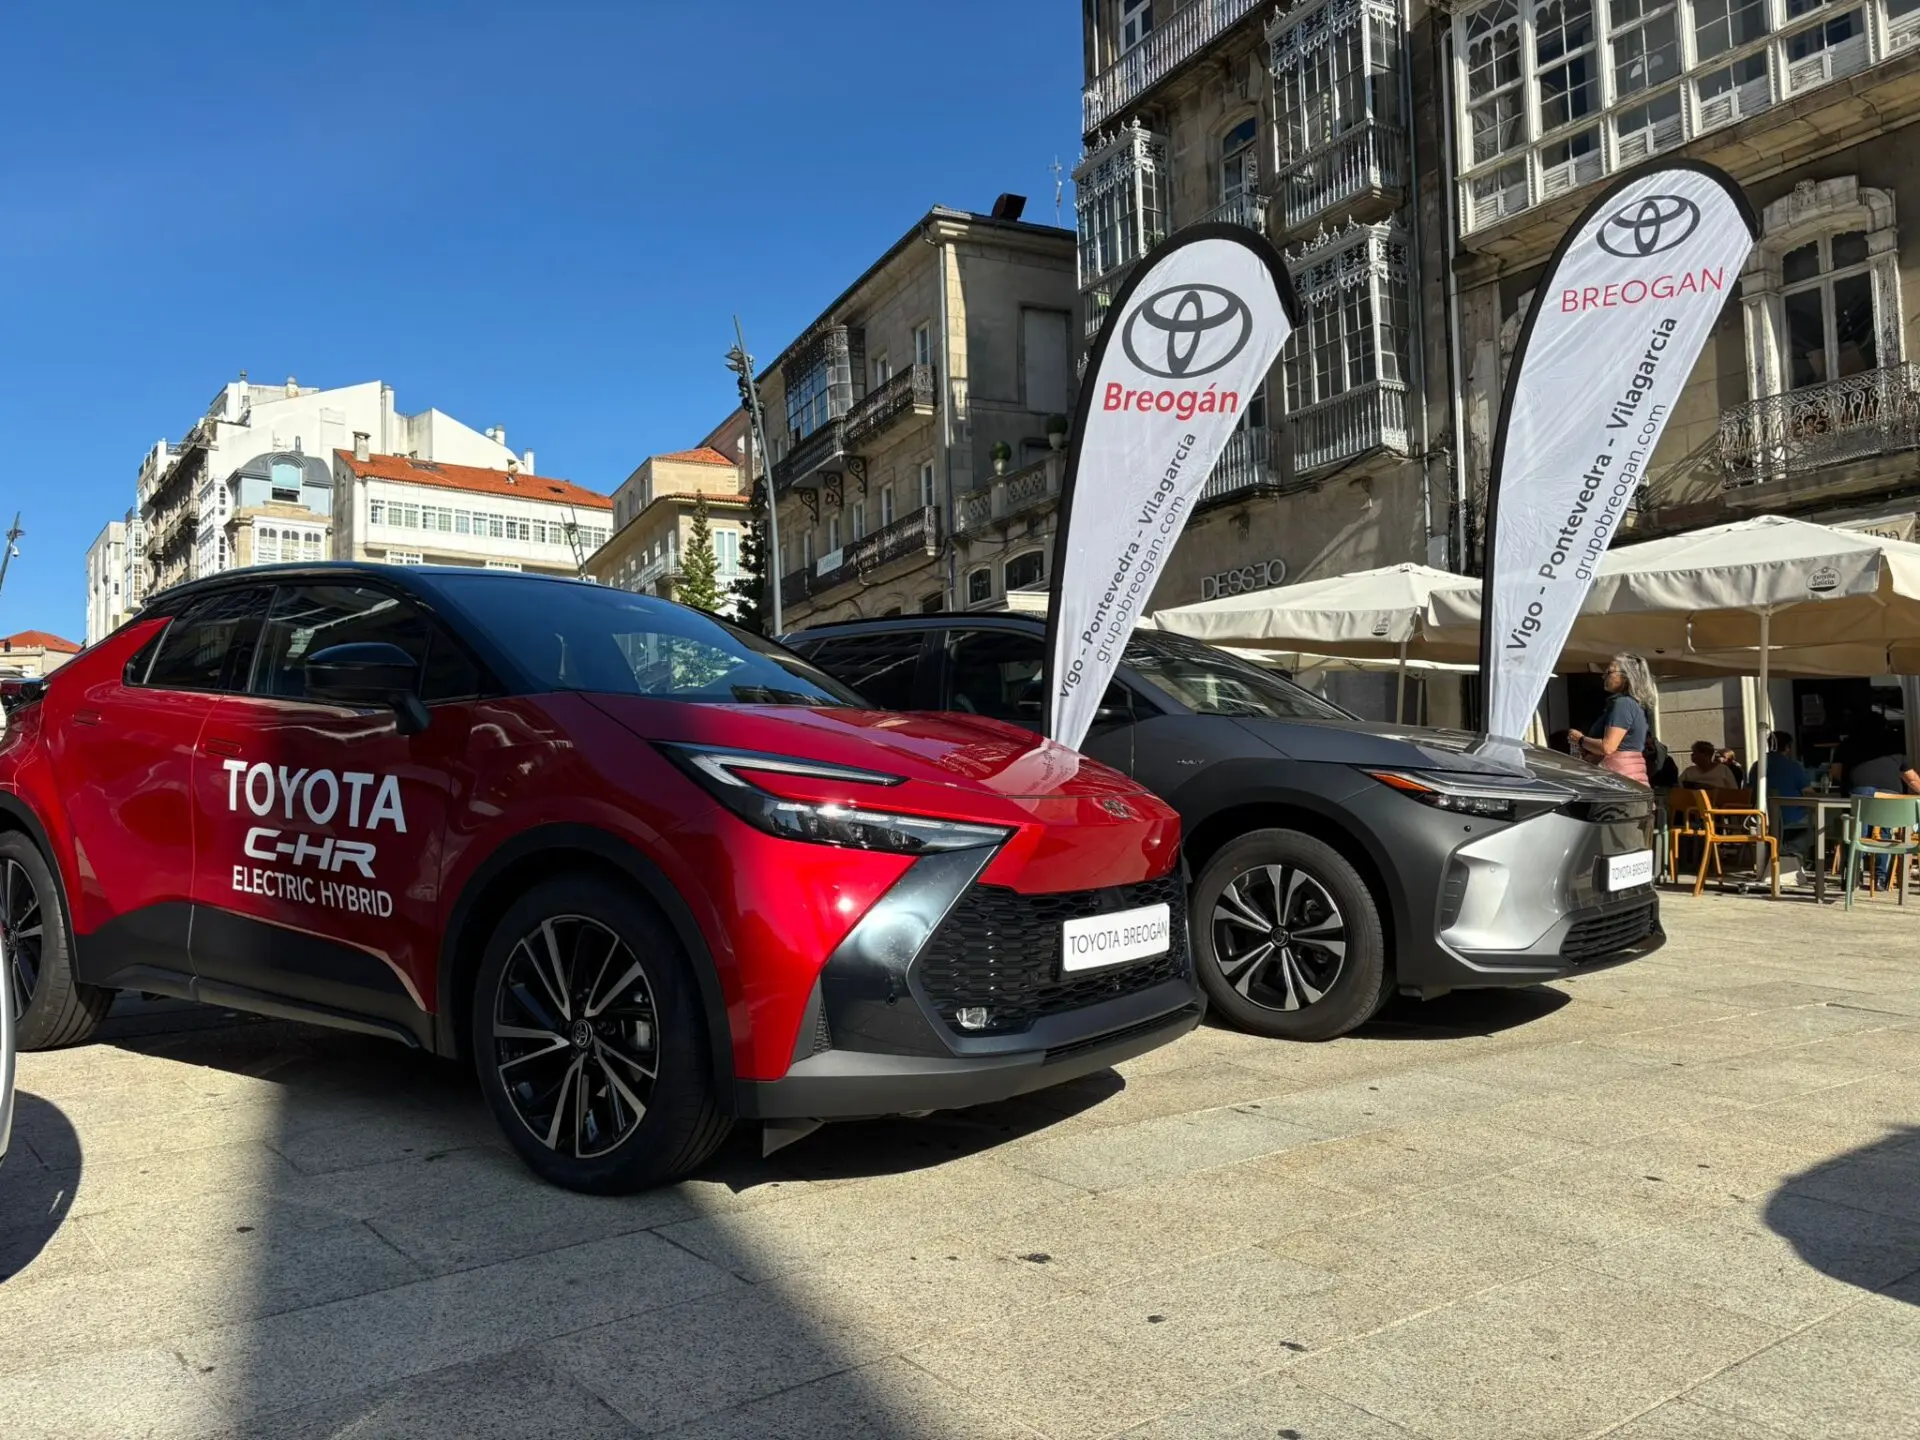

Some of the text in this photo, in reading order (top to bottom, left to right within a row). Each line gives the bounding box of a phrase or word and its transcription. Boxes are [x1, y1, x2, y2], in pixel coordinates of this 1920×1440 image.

[1561, 266, 1723, 313] BREOGAN
[1103, 382, 1239, 421] Breogán
[1506, 601, 1543, 652] Vigo
[1538, 453, 1612, 580] Pontevedra
[1606, 317, 1677, 430] Vilagarcía
[1575, 404, 1667, 581] grupobreogan.com
[1060, 661, 1084, 698] Vigo
[1081, 543, 1140, 646] Pontevedra
[1138, 432, 1196, 527] Vilagarcía
[1096, 494, 1186, 664] grupobreogan.com
[1201, 559, 1286, 601] DESSEO
[223, 759, 407, 833] TOYOTA
[244, 827, 377, 878] C-HR
[232, 865, 393, 918] ELECTRIC HYBRID
[1069, 917, 1168, 956] TOYOTA BREOGÁN
